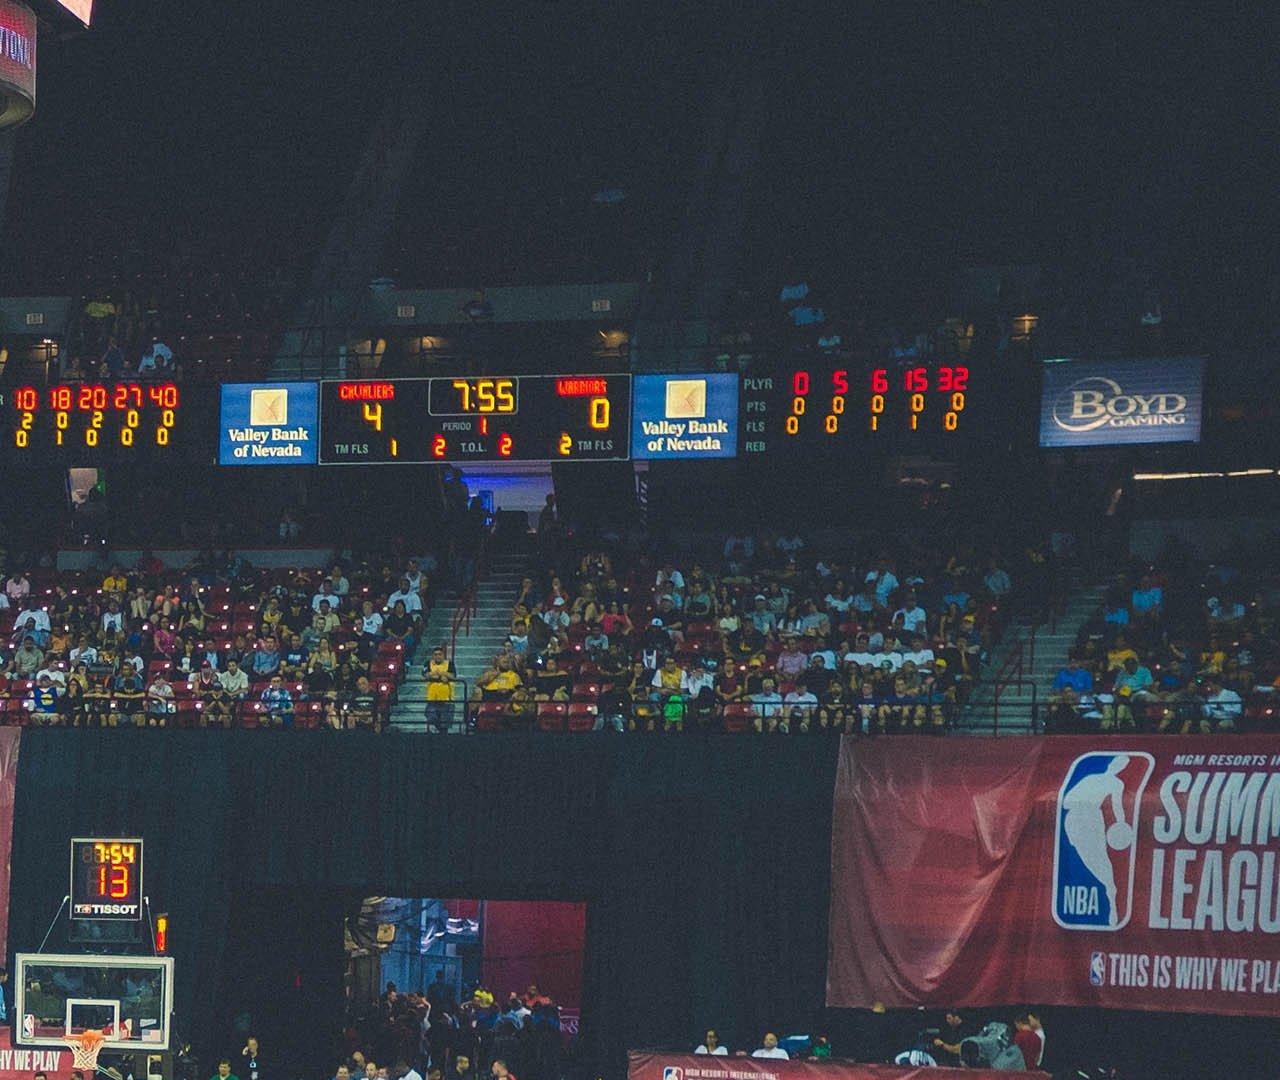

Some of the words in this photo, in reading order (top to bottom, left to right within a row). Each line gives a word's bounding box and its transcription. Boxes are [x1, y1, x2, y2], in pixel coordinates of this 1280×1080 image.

[744, 377, 773, 390] PLYR
[792, 371, 809, 395] 0
[833, 371, 849, 394] 5
[872, 369, 888, 392] 6
[905, 368, 928, 391] 15
[937, 367, 969, 390] 32
[16, 390, 37, 410] 10
[51, 386, 72, 410] 18
[79, 386, 107, 410] 20
[114, 385, 143, 409] 27
[150, 384, 179, 408] 40
[453, 380, 514, 412] 7:55
[746, 401, 767, 412] PTS
[792, 396, 805, 415] 0
[832, 395, 845, 414] 0
[872, 395, 884, 413] 0
[911, 394, 924, 412] 0
[952, 392, 964, 411] 0
[22, 413, 33, 430] 2
[56, 411, 68, 429] 0
[92, 411, 103, 429] 2
[127, 410, 139, 428] 0
[163, 409, 174, 428] 0
[364, 403, 382, 431] 4
[591, 398, 610, 429] 0
[746, 421, 766, 432] FLS
[786, 416, 798, 434] 0
[944, 412, 957, 431] 0
[1109, 414, 1185, 427] GAMING
[228, 428, 267, 446] Valley
[271, 426, 308, 442] Bank
[480, 417, 487, 434] 1
[642, 420, 681, 438] Valley
[687, 418, 728, 434] Bank
[16, 430, 27, 447] 0
[86, 428, 97, 446] 0
[121, 428, 133, 446] 0
[157, 427, 169, 446] 0
[334, 444, 350, 455] TM
[351, 444, 369, 454] FLS
[390, 439, 397, 456] 1
[435, 437, 446, 456] 2
[499, 435, 512, 455] 2
[559, 435, 572, 455] 2
[577, 441, 593, 451] TM
[594, 440, 613, 451] FLS
[647, 436, 662, 451] of
[665, 434, 721, 451] Nevada
[745, 441, 766, 452] REB
[234, 442, 248, 458] of
[252, 441, 302, 458] Nevada
[1174, 754, 1205, 766] MGM
[1208, 754, 1267, 767] RESORTS
[95, 843, 136, 864] 7:54
[99, 866, 129, 898] 13
[91, 904, 137, 915] TISSOT
[1063, 886, 1100, 915] NBA
[1109, 953, 1149, 988] THIS
[1152, 954, 1172, 989] IS
[1175, 956, 1218, 990] WHY
[1220, 957, 1249, 992] WE
[14, 1050, 32, 1071] WE
[32, 1050, 61, 1072] PLAY
